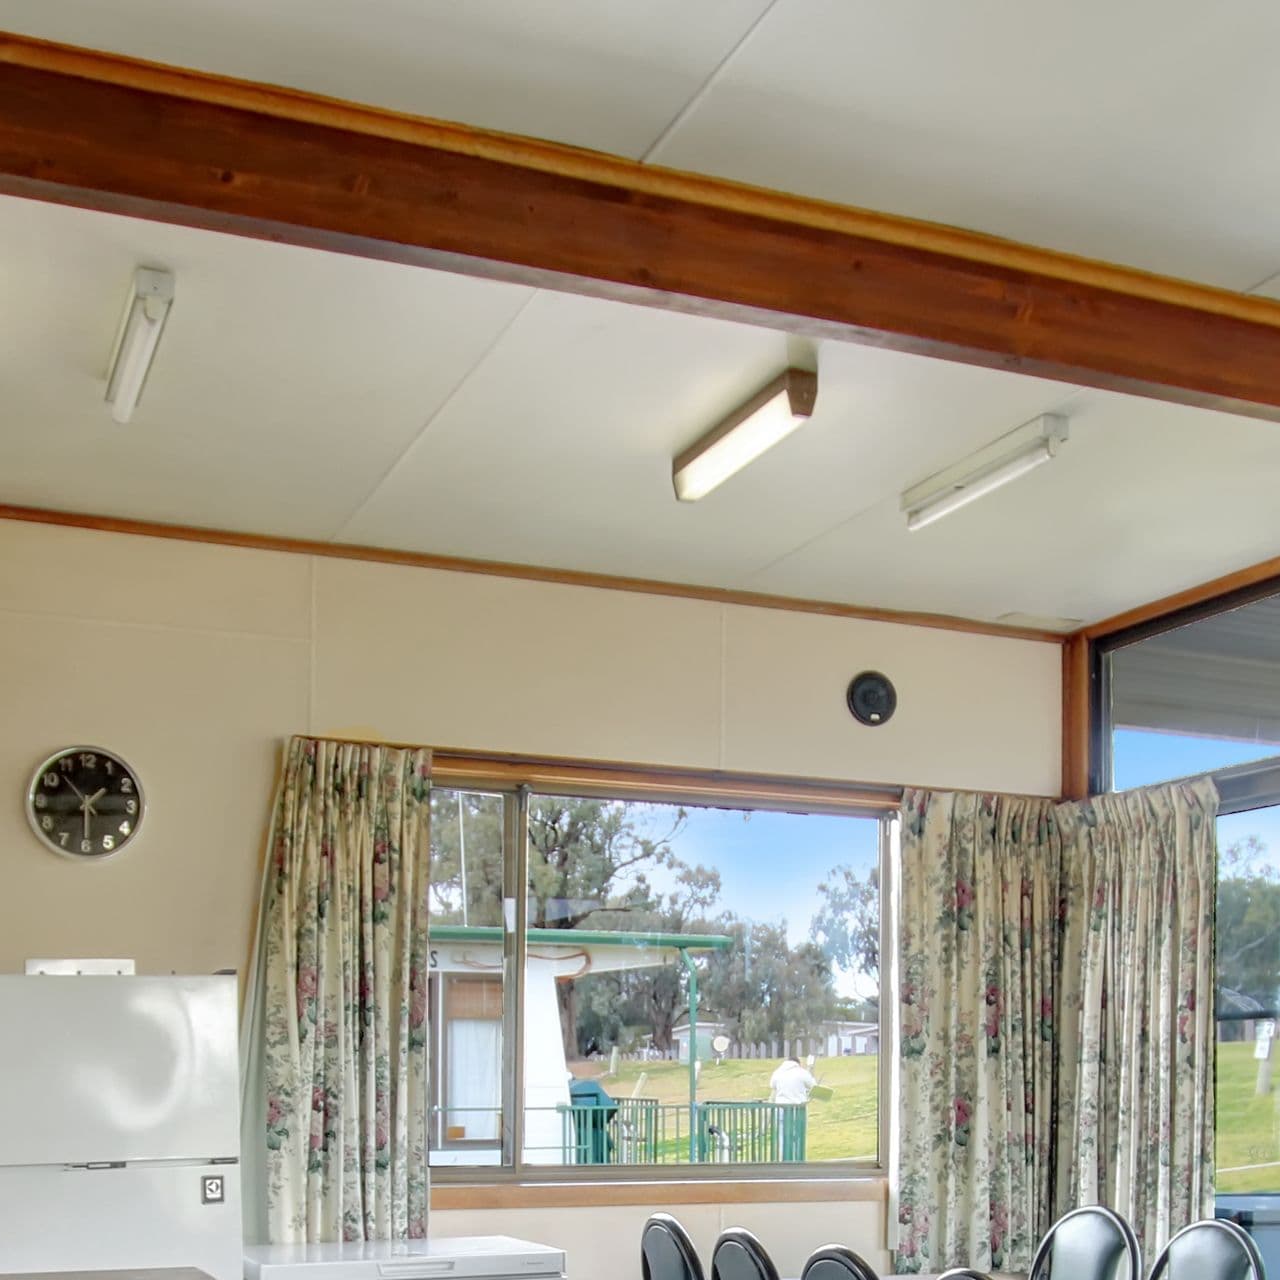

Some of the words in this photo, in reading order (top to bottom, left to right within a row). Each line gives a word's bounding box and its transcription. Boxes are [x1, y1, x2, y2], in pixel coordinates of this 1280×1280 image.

[59, 758, 73, 772] 11
[80, 754, 97, 768] 12
[105, 761, 113, 775] 1
[43, 772, 59, 787] 10
[120, 777, 132, 793] 2
[35, 794, 47, 808] 9
[126, 800, 136, 814] 3
[42, 816, 53, 831] 8
[119, 821, 130, 836] 4
[59, 832, 70, 846] 7
[81, 839, 91, 853] 6
[102, 835, 114, 850] 5
